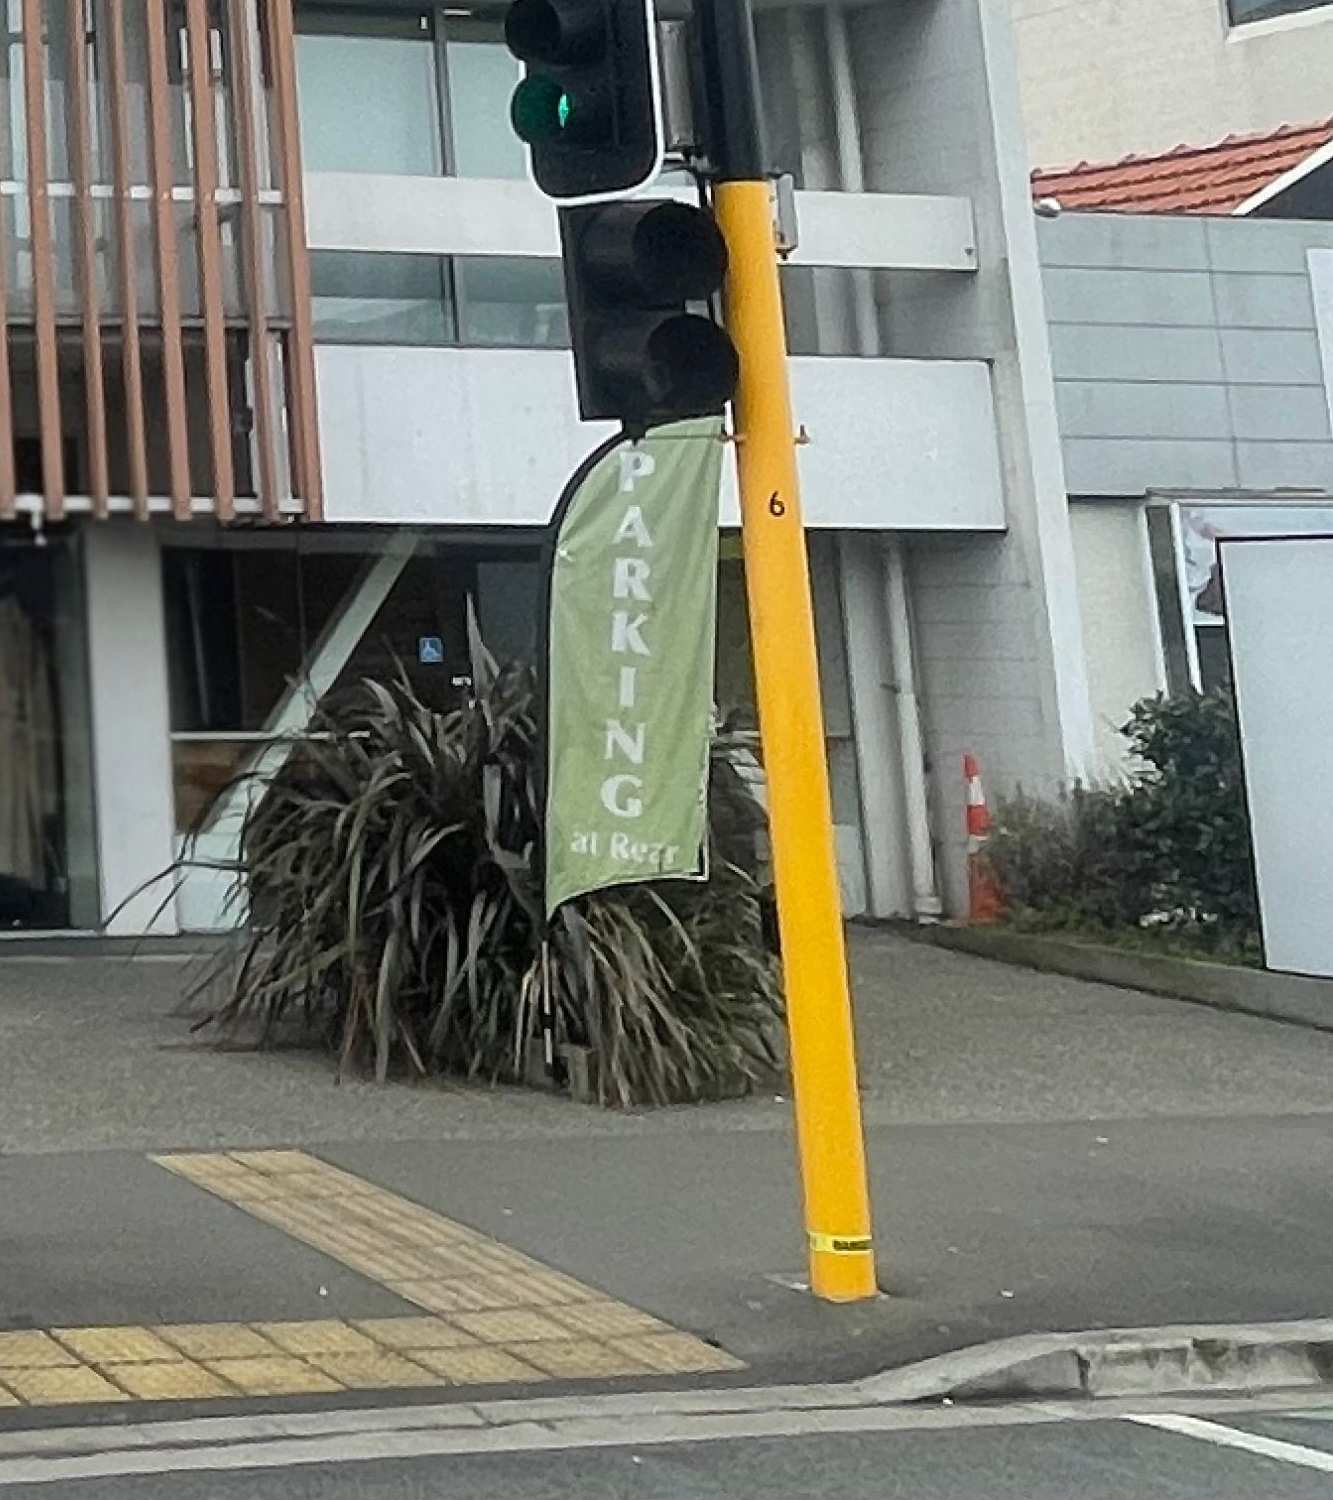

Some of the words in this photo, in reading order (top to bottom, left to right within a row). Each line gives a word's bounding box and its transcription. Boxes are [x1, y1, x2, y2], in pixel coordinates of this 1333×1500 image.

[768, 490, 786, 516] 6
[601, 450, 656, 819] PARKING
[569, 830, 597, 856] at
[609, 831, 680, 864] Rear
